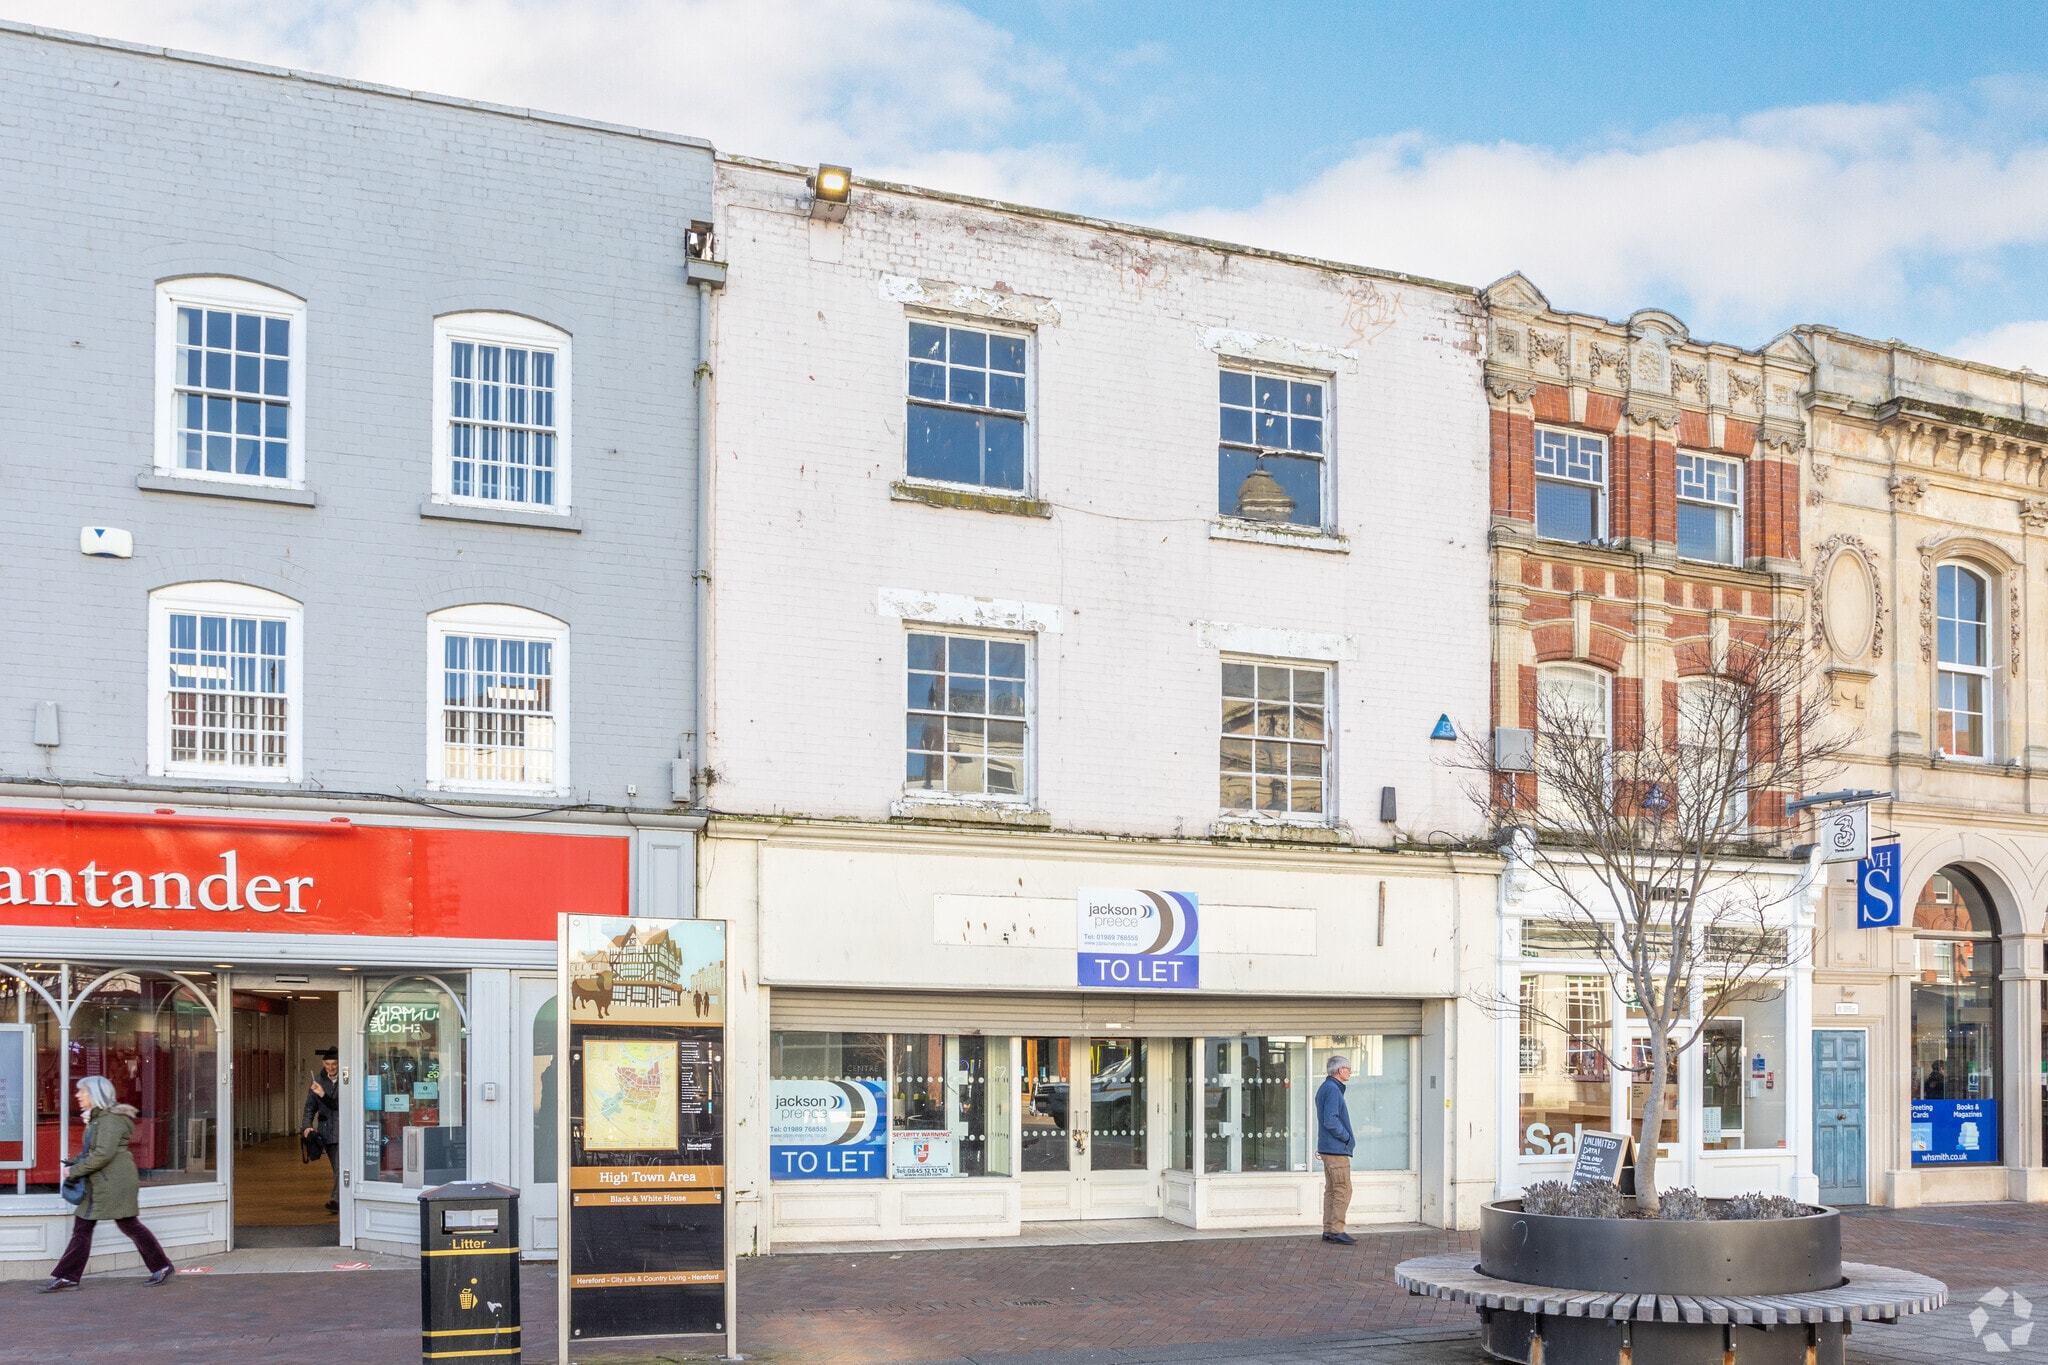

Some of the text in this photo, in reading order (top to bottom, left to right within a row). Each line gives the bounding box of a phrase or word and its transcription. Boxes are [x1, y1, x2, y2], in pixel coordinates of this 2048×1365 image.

[1864, 851, 1892, 869] WH
[0, 850, 314, 912] antander
[1089, 903, 1137, 917] jackson
[1094, 916, 1139, 928] preece
[1095, 959, 1183, 982] TO LET
[775, 1095, 827, 1109] jackson
[1911, 1104, 1933, 1112] reeting
[1584, 1136, 1617, 1150] UNLIMITED
[781, 1150, 875, 1173] TO LET
[1922, 1153, 1967, 1161] whsmith.co.uk
[1576, 1161, 1581, 1170] 3
[600, 1171, 696, 1185] High Town Area
[610, 1195, 630, 1203] Black
[663, 1194, 687, 1202] House
[452, 1239, 487, 1249] Litter
[644, 1275, 667, 1283] Country
